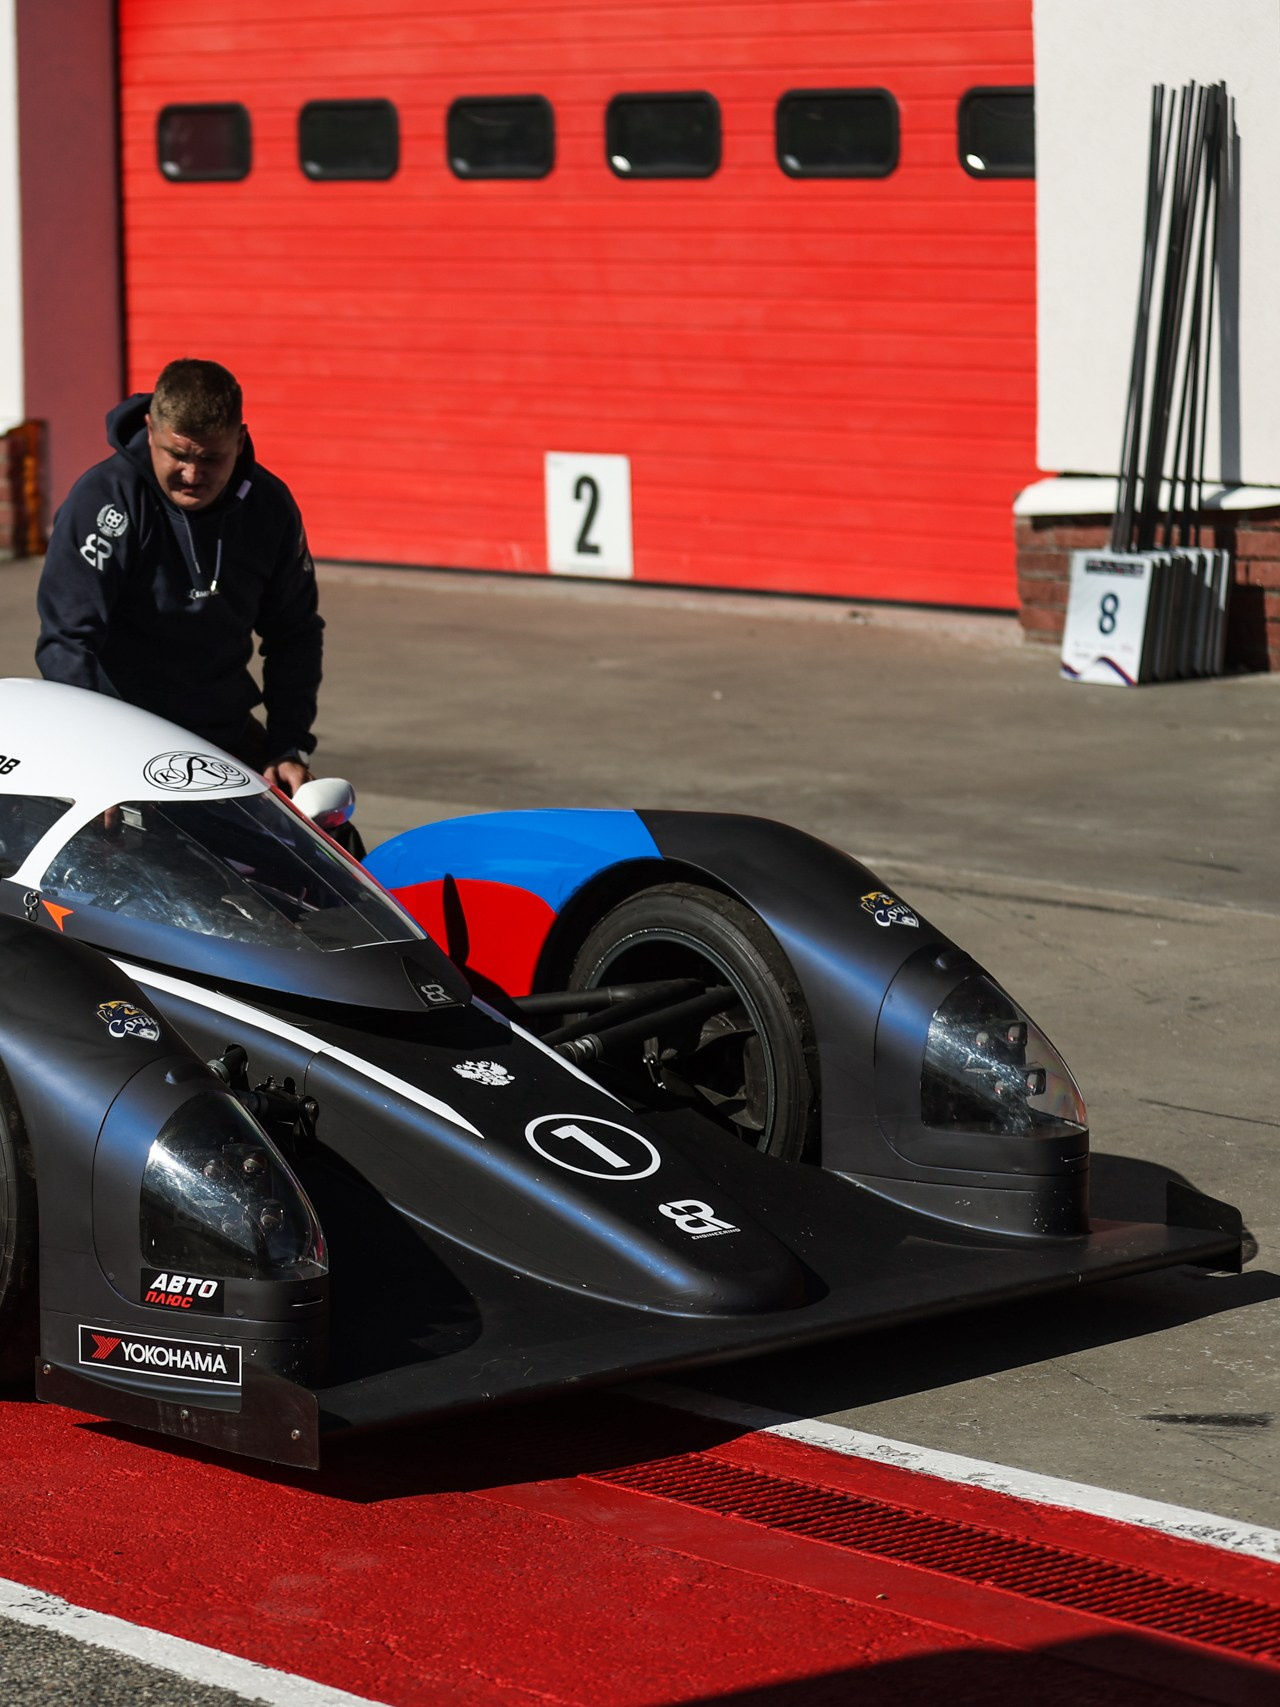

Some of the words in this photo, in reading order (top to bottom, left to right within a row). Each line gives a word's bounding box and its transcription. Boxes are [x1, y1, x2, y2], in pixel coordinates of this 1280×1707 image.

[574, 475, 601, 555] 2
[1099, 593, 1119, 635] 8
[550, 1124, 632, 1169] 1
[145, 1290, 194, 1309] ПЛЮС
[150, 1273, 218, 1299] АВТО
[121, 1341, 227, 1374] YOKOHAMA
